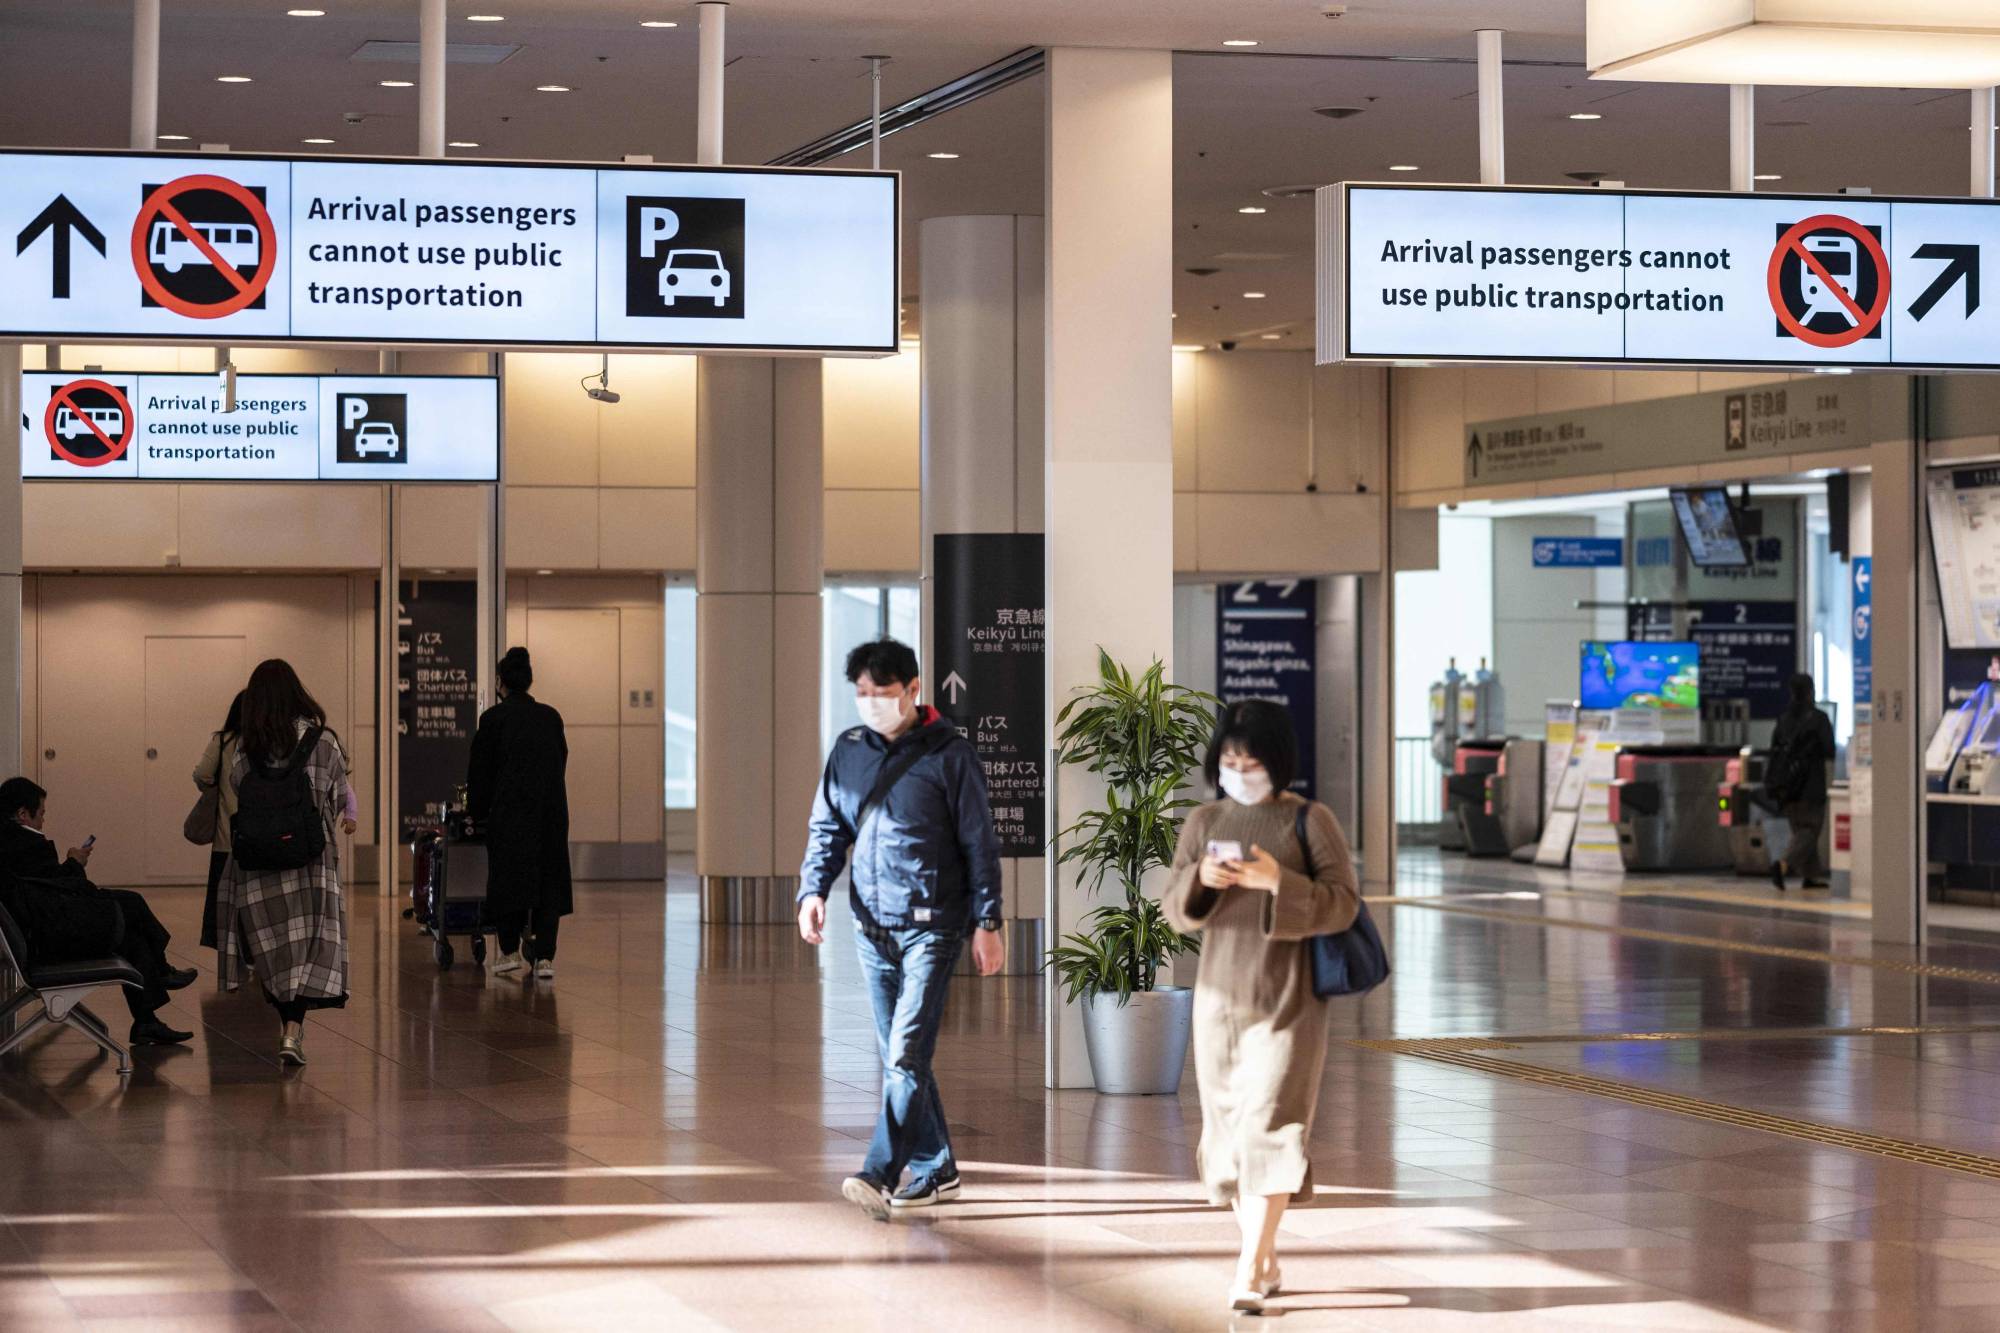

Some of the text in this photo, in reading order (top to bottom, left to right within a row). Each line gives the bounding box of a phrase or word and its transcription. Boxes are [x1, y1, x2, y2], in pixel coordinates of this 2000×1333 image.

[308, 196, 577, 231] Arrival passengers
[308, 241, 562, 271] cannot use public
[1381, 239, 1731, 273] Arrival passengers cannot
[308, 281, 523, 311] transportation
[1381, 283, 1724, 314] use public transportation
[148, 395, 307, 414] Arrival pssengers
[148, 420, 299, 438] cannot use public
[1789, 418, 1812, 439] Line
[148, 444, 275, 462] transportation
[967, 626, 1016, 642] Keikyū
[417, 682, 468, 693] Chartered
[416, 719, 456, 731] Parking
[977, 716, 1008, 729] バス
[977, 731, 999, 743] Bus
[986, 776, 1039, 789] hartered
[989, 807, 1025, 821] 車場
[992, 822, 1025, 837] rking
